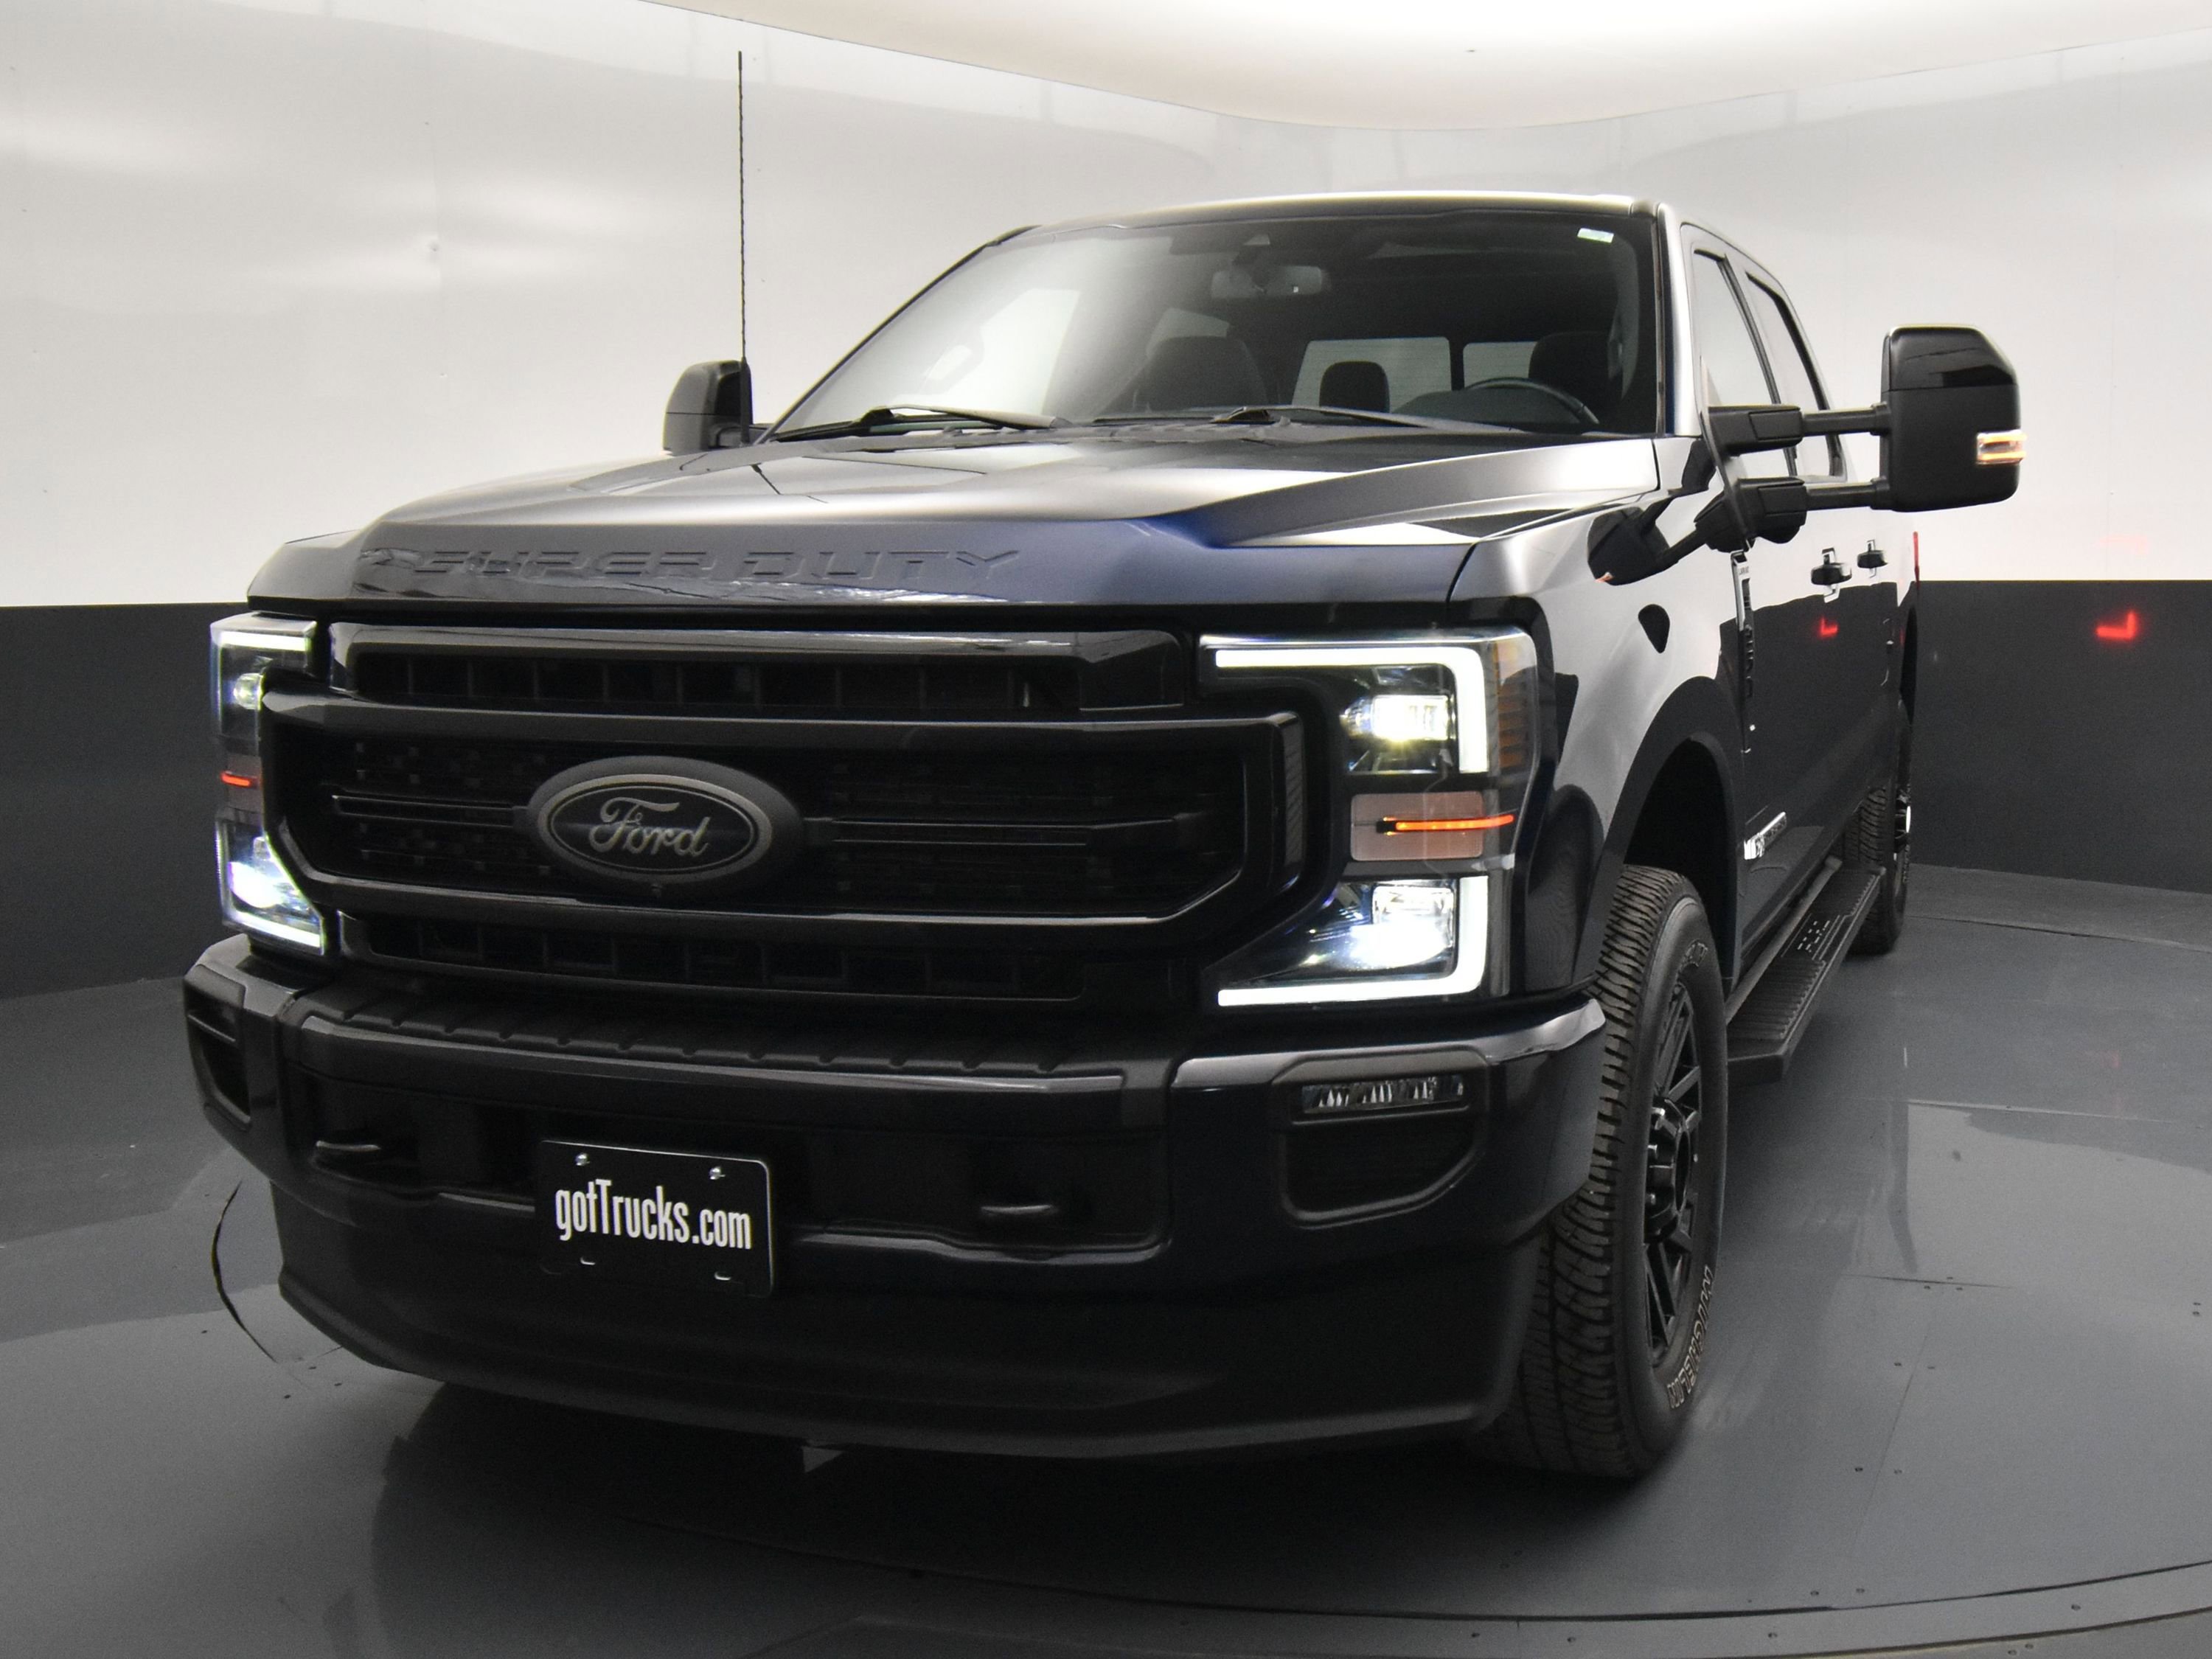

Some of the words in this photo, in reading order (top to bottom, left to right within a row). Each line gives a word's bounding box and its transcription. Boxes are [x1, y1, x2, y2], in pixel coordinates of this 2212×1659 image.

[740, 550, 1020, 580] DUTY
[590, 796, 711, 858] Ford
[555, 1178, 751, 1250] gotTrucks.com
[1666, 1264, 1714, 1409] MICHELIN
